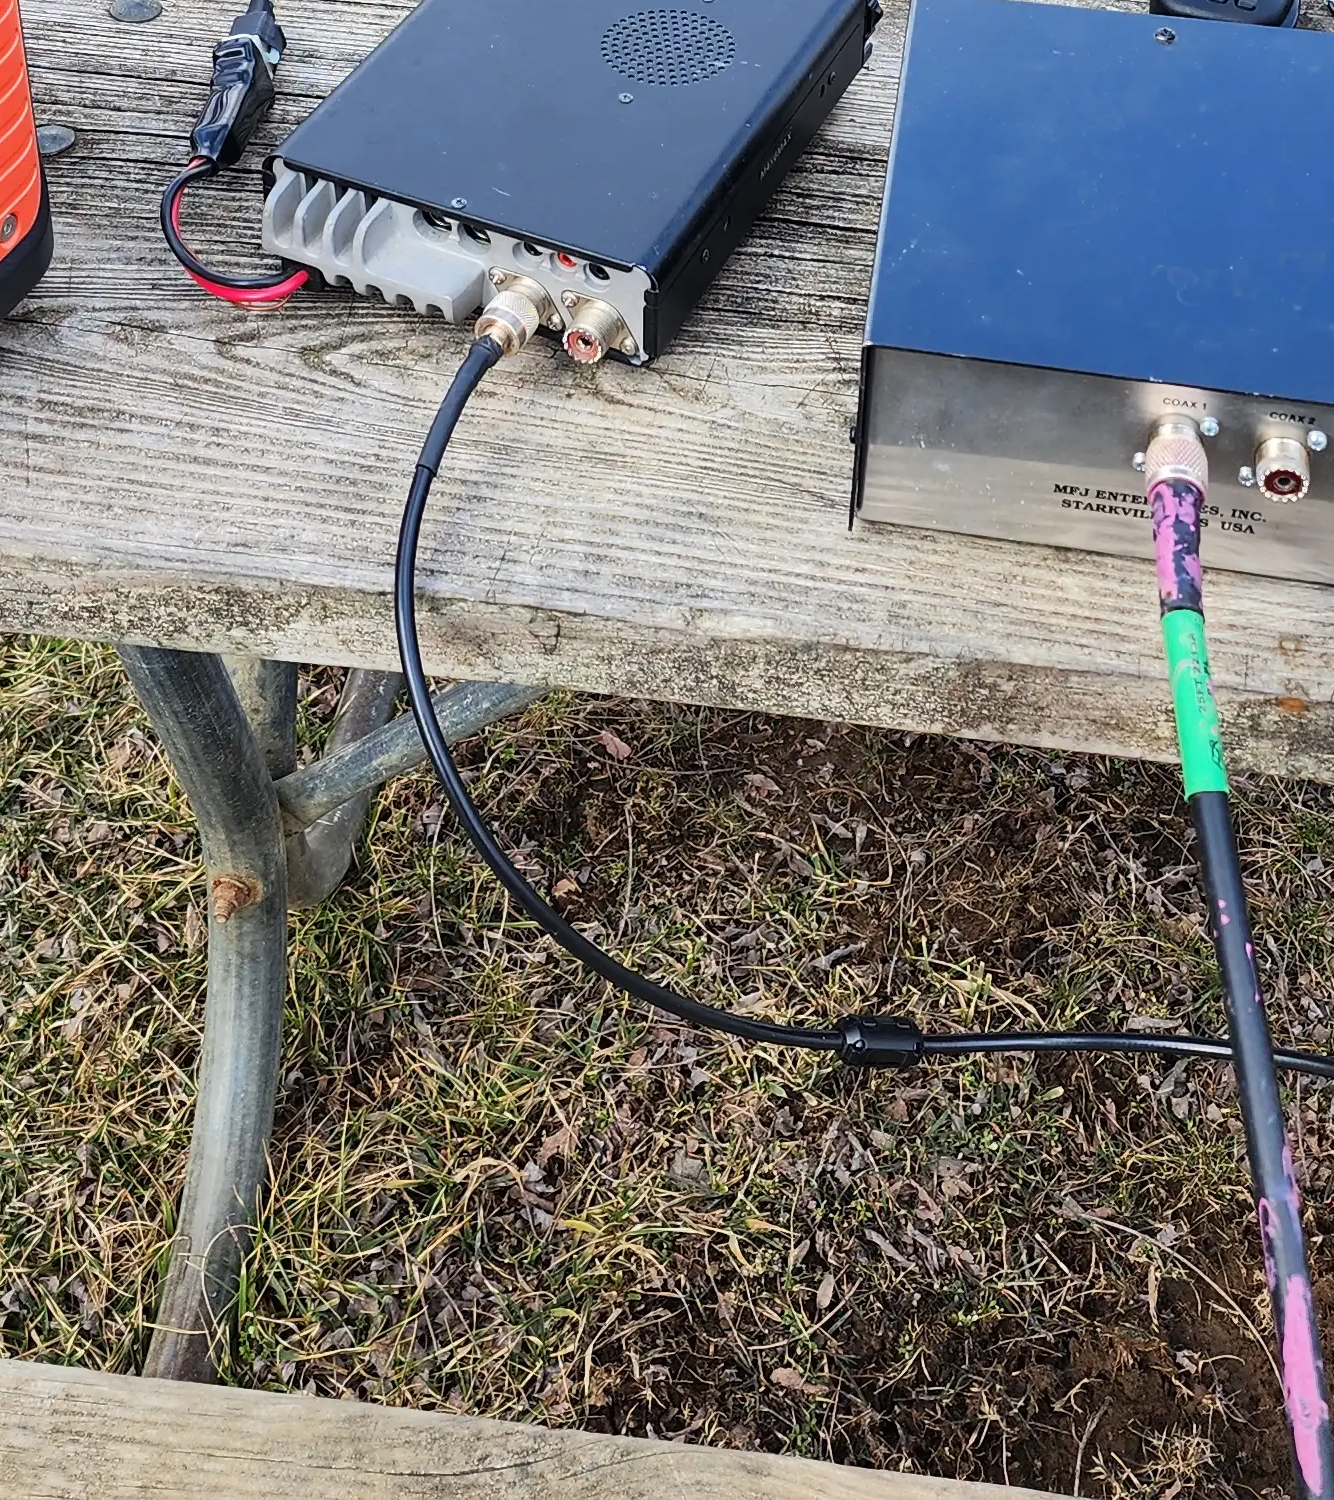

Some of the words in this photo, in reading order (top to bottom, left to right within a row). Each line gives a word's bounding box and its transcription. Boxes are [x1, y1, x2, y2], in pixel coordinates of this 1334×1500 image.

[1163, 397, 1198, 410] COAX
[1202, 402, 1207, 411] 1
[1269, 410, 1307, 425] COAX
[1307, 416, 1317, 426] 2
[1053, 484, 1091, 498] MFJ
[1231, 508, 1267, 523] INC.
[1221, 521, 1255, 535] USA
